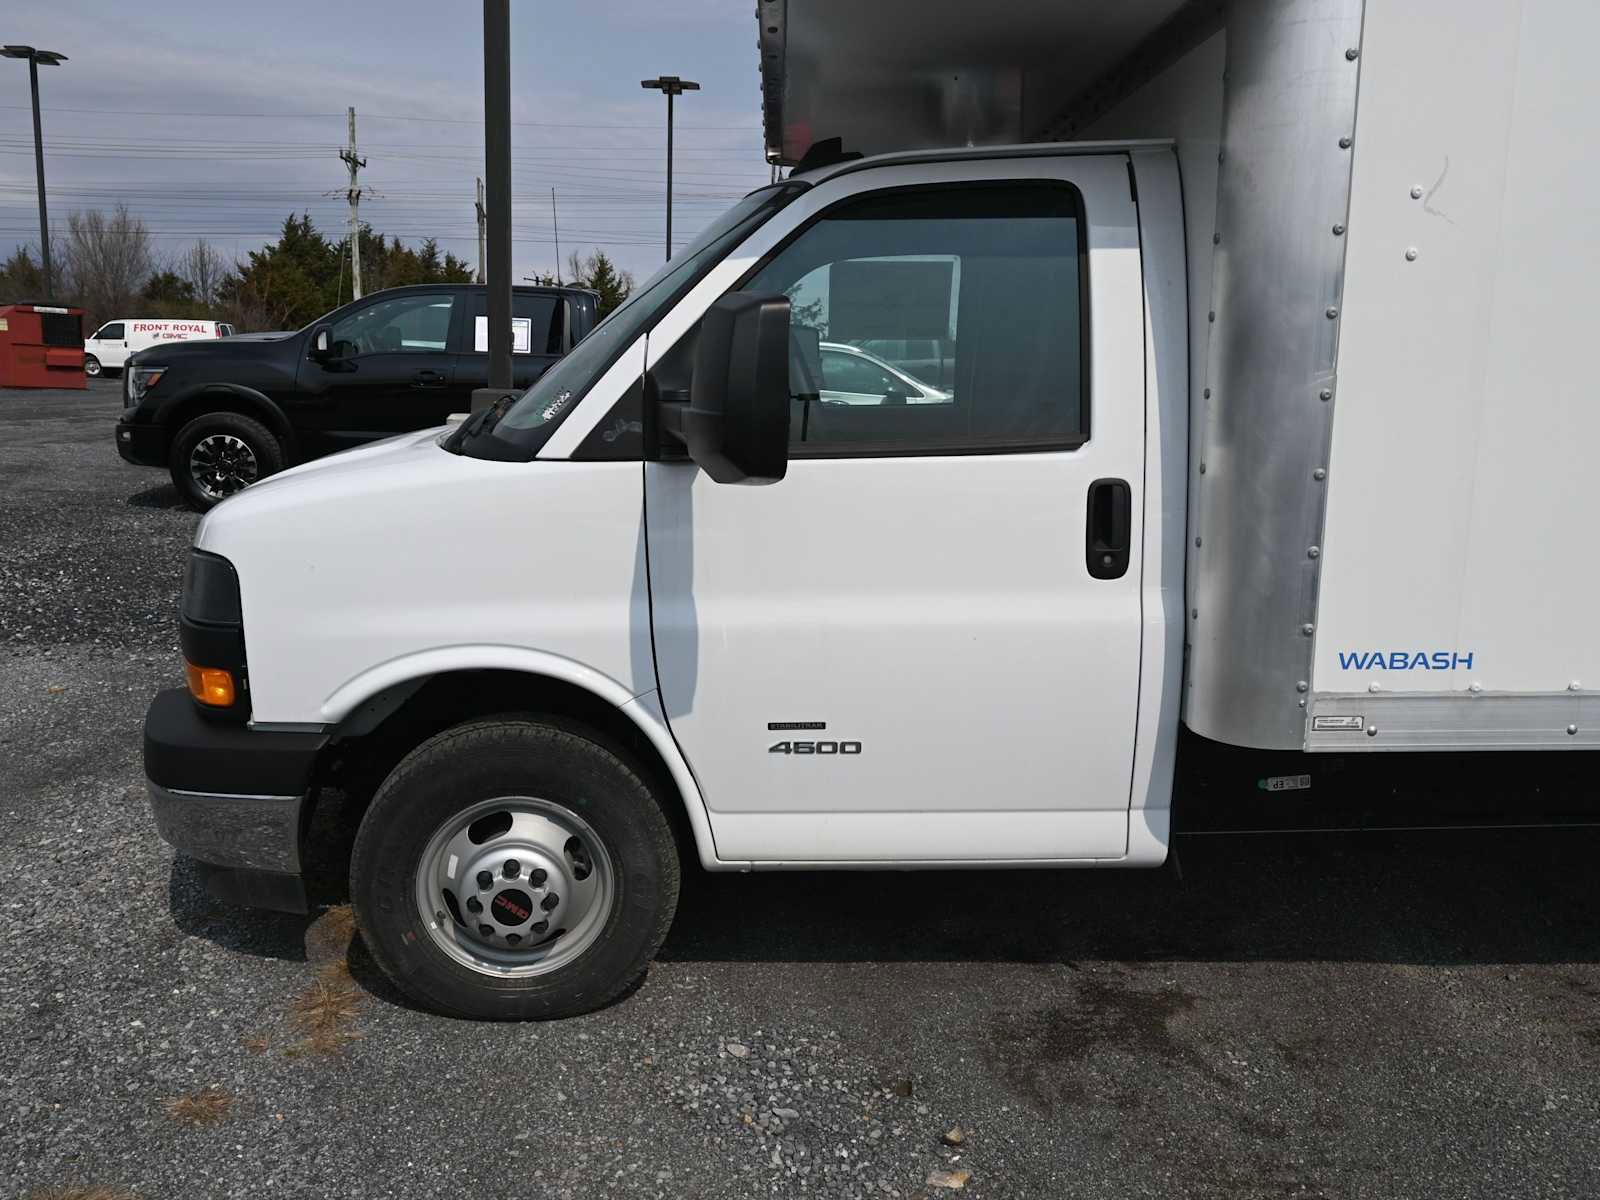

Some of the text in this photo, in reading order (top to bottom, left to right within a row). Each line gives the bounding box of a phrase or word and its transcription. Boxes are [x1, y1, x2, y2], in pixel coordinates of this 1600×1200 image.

[133, 323, 207, 333] FRONT ROYAL
[162, 332, 188, 340] GMC
[1338, 652, 1473, 670] WABASH
[768, 741, 862, 754] 4500
[495, 895, 529, 919] GMC
